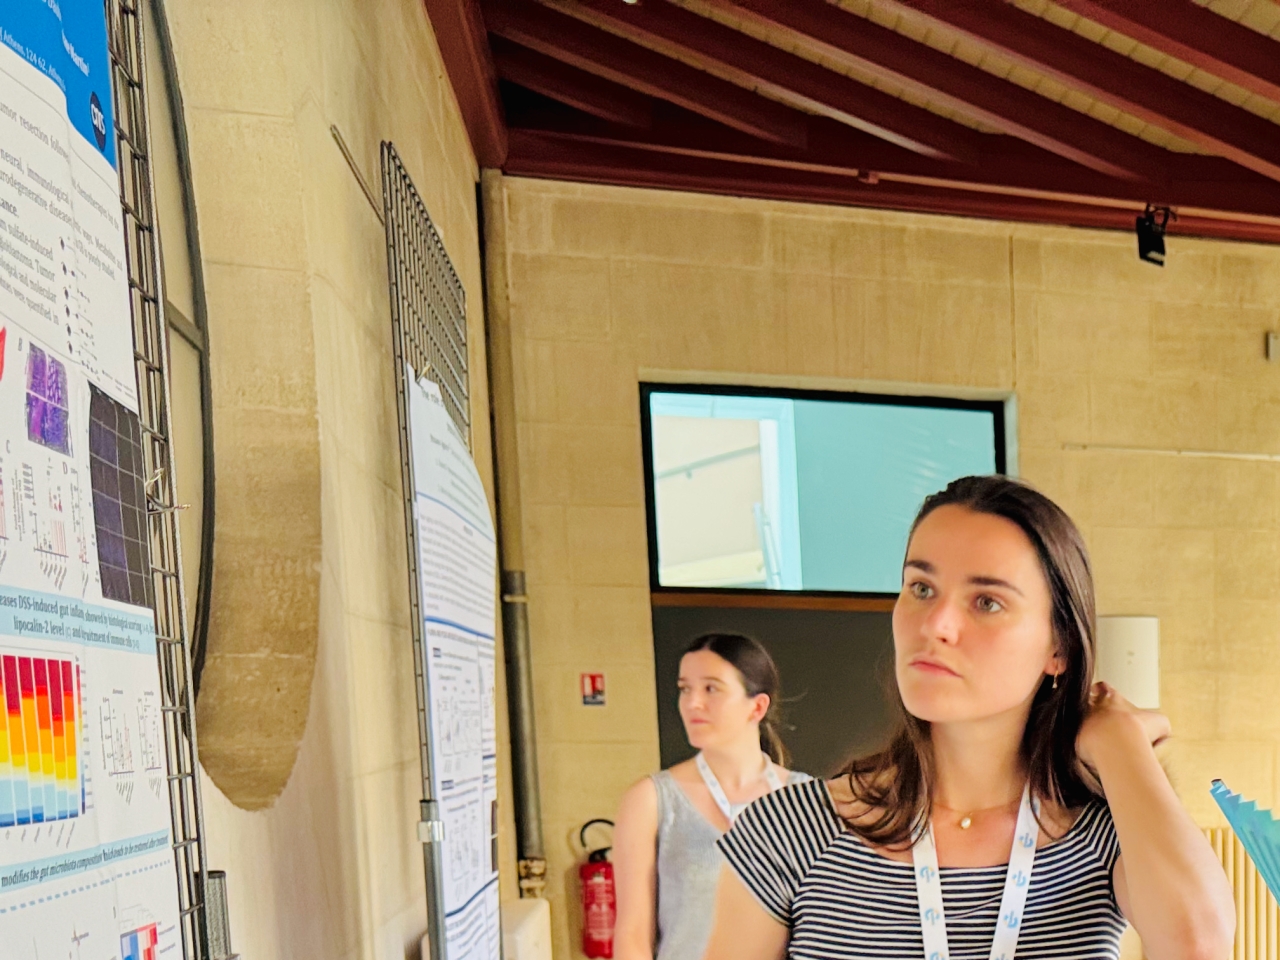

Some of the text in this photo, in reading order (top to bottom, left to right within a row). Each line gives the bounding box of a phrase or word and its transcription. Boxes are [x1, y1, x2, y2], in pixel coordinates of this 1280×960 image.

[0, 594, 17, 609] eases
[18, 595, 58, 614] DSS-induced
[59, 603, 69, 619] gut
[13, 616, 49, 635] lipocalin-2
[50, 621, 65, 636] level
[1, 869, 30, 888] modifies
[30, 866, 40, 880] the
[39, 866, 49, 883] gut
[49, 858, 76, 876] microbiota
